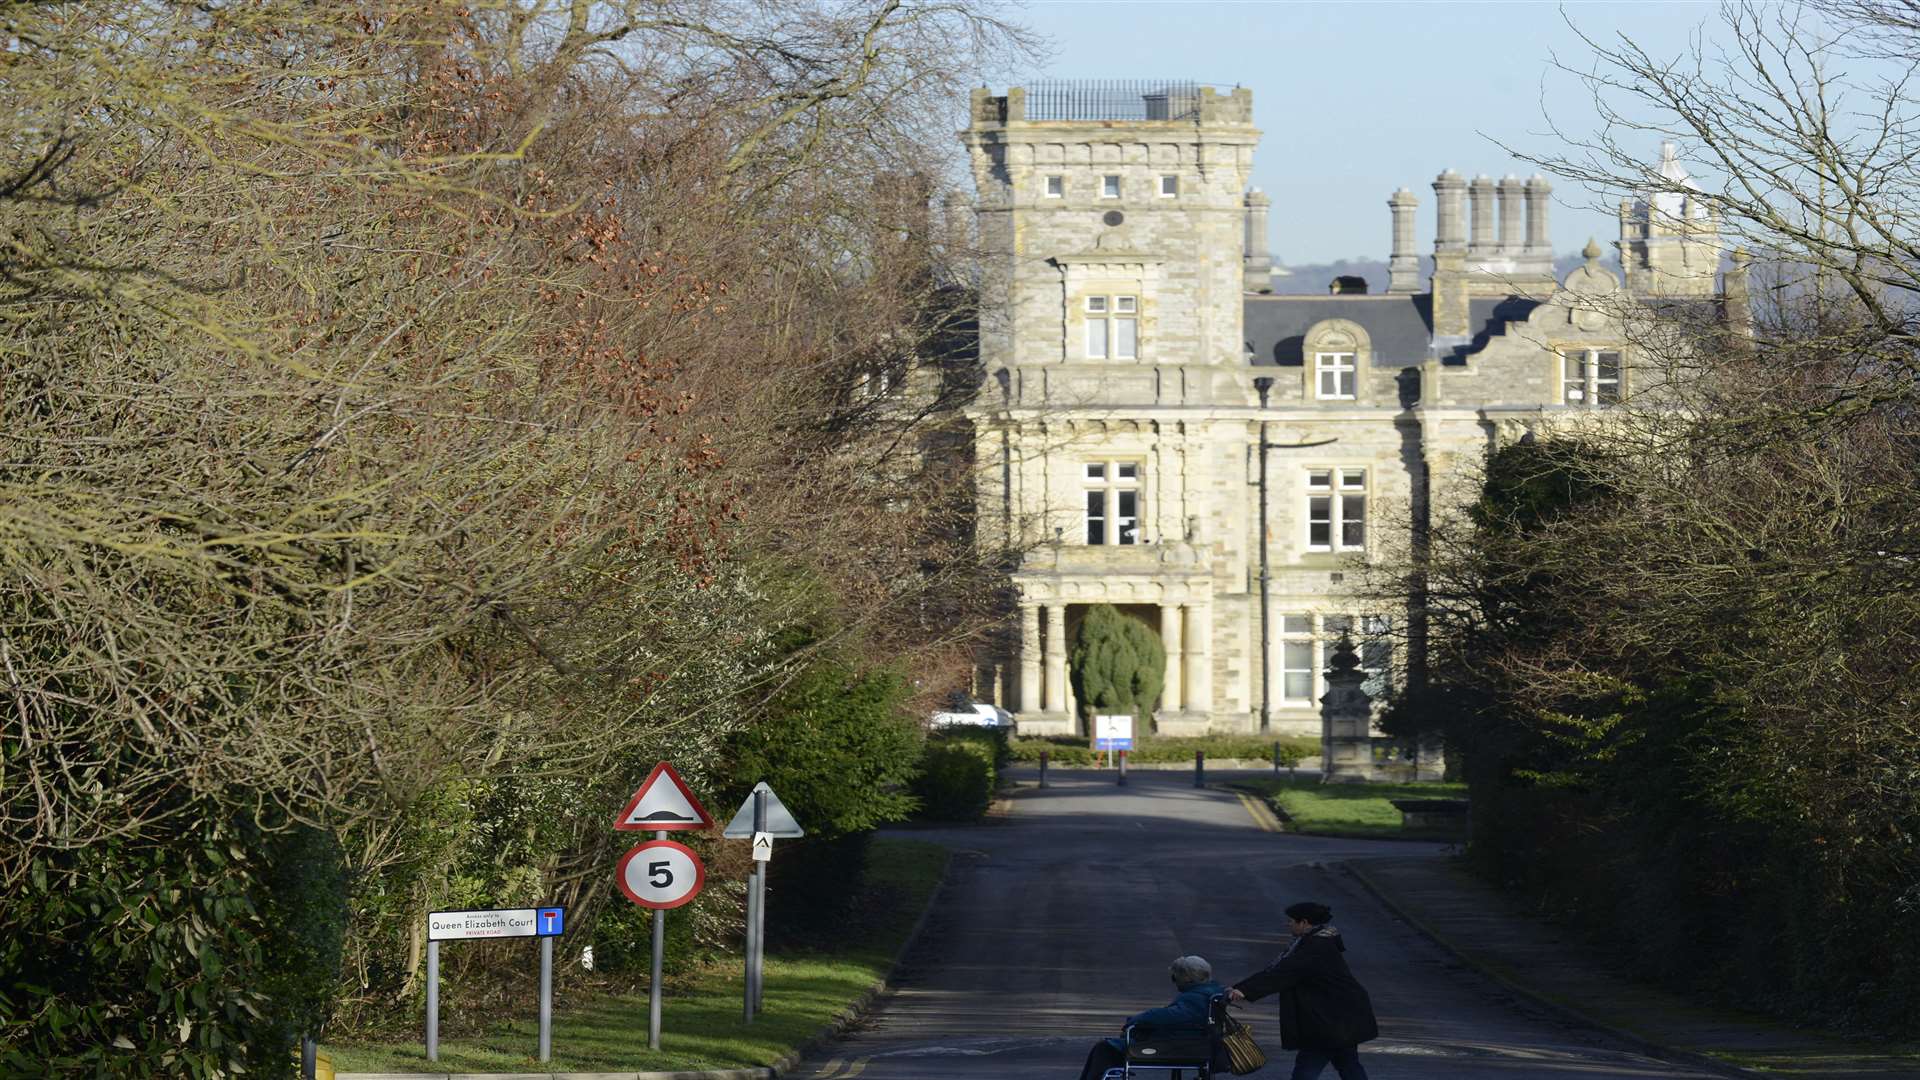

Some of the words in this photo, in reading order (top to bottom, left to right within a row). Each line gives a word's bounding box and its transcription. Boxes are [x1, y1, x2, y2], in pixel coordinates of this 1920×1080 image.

[648, 861, 674, 888] 5
[432, 921, 462, 930] Queen
[465, 918, 506, 929] Elizabeth
[508, 918, 533, 927] Court
